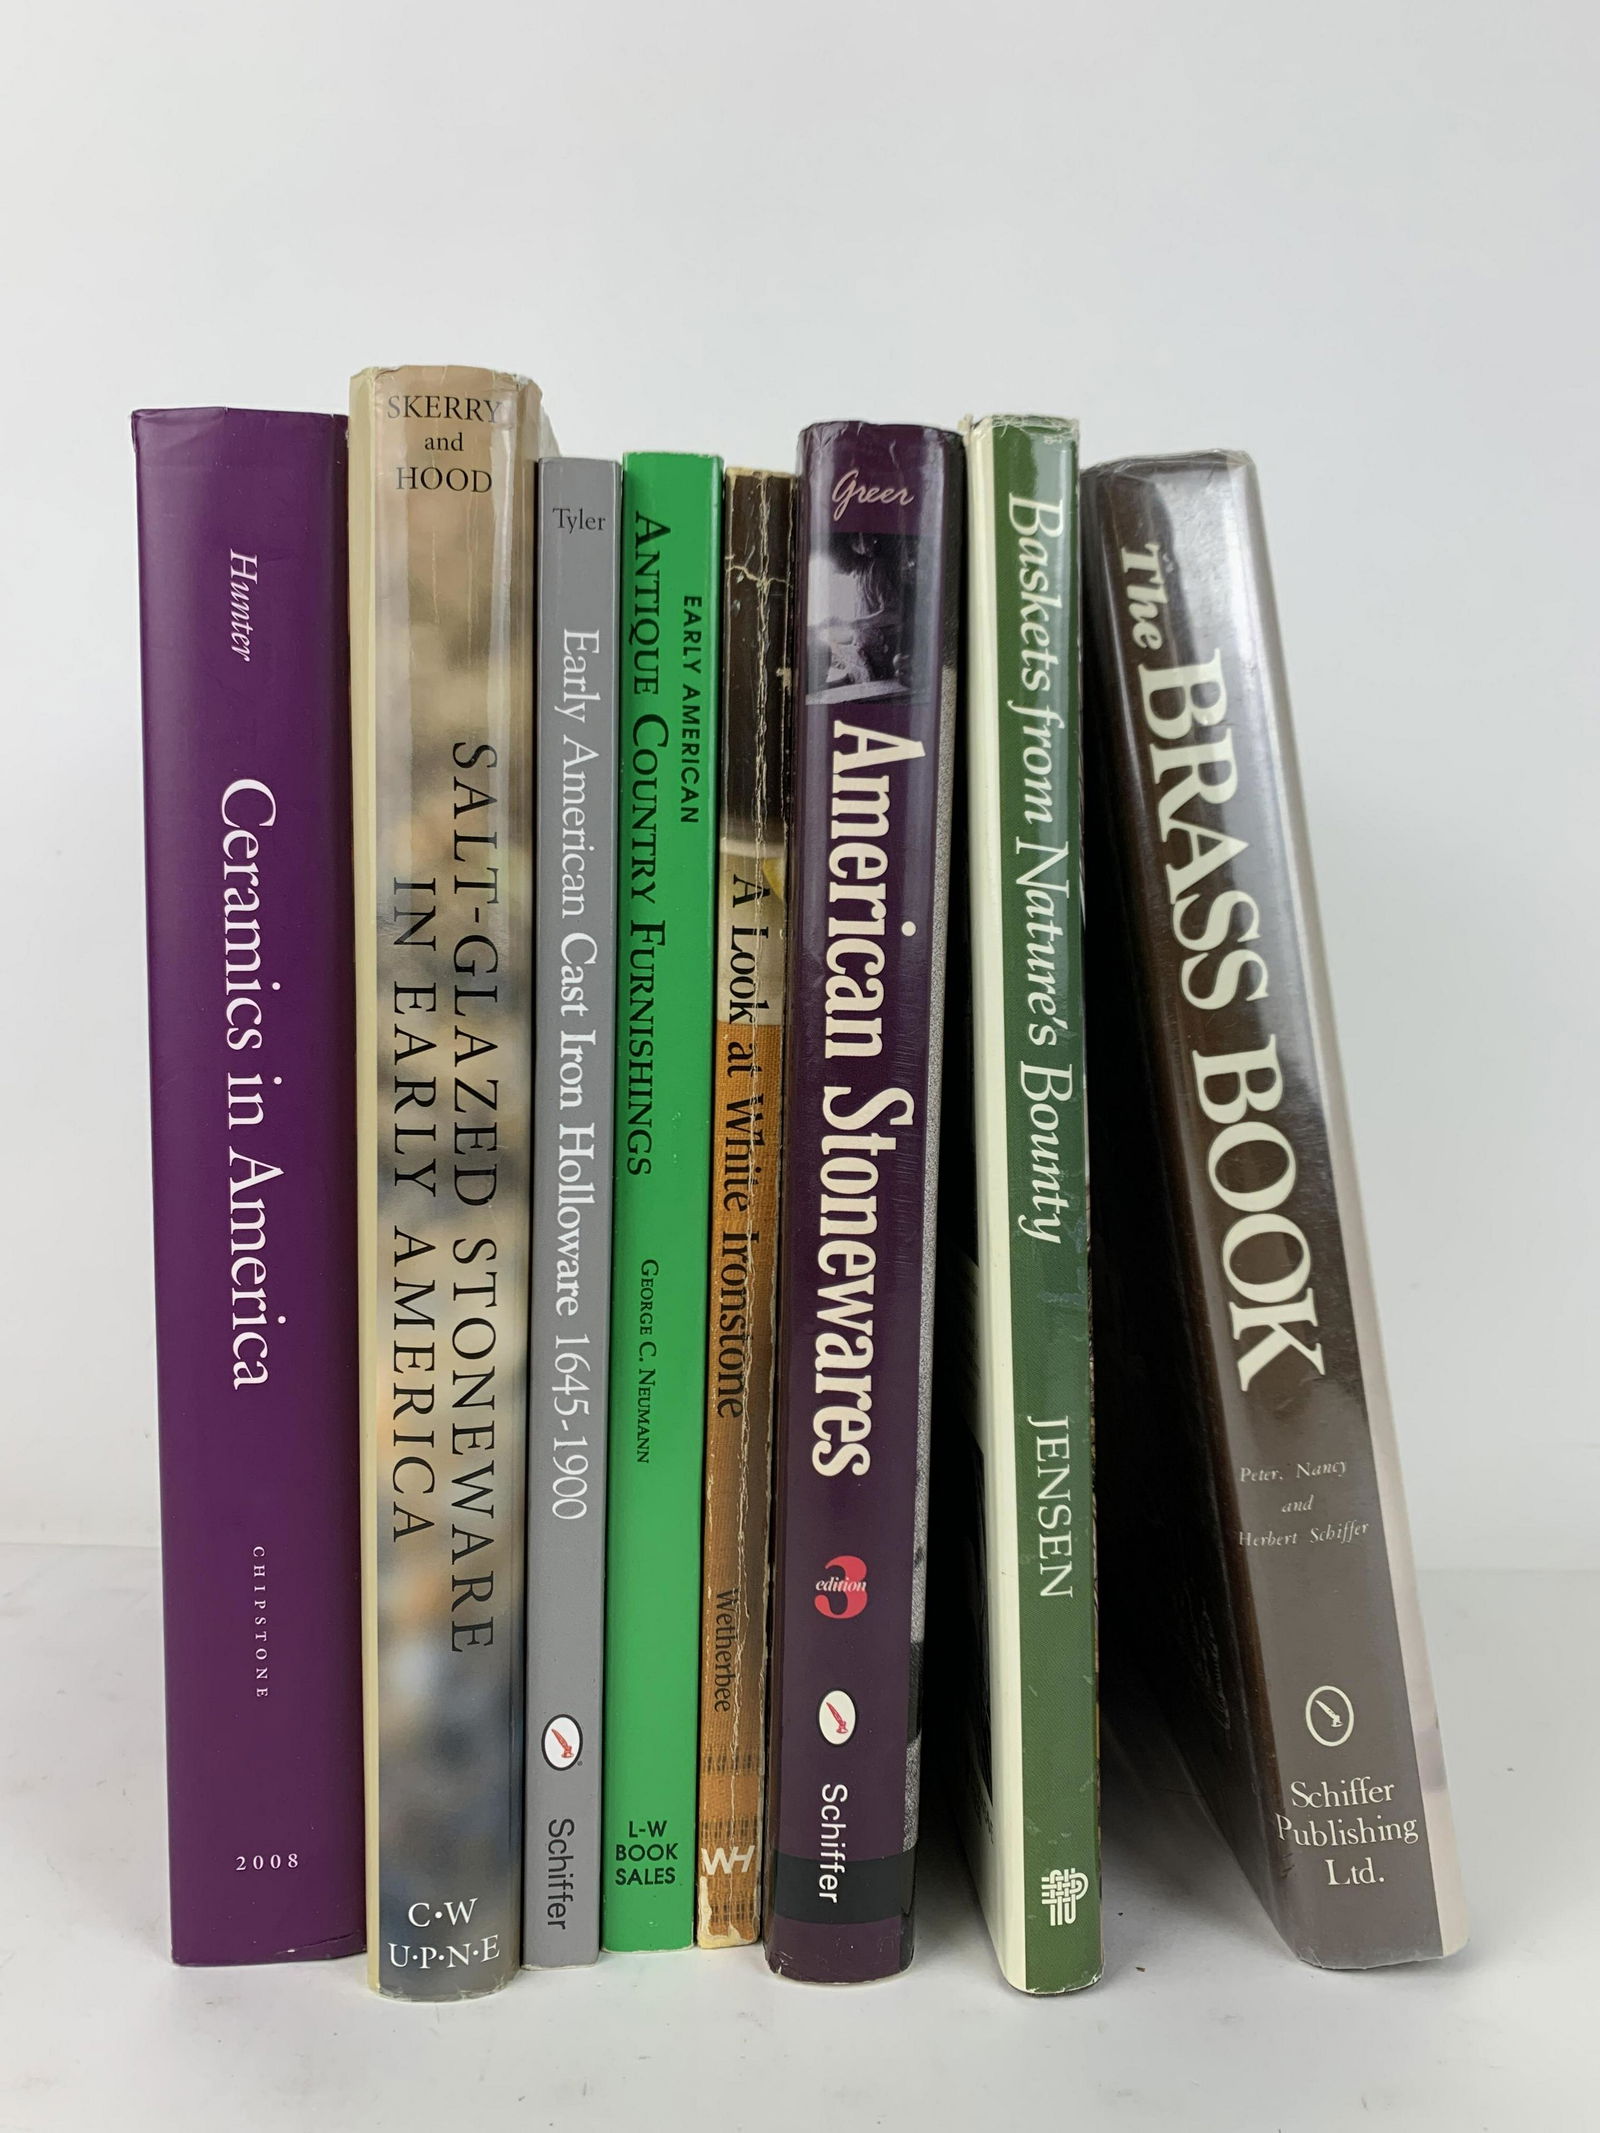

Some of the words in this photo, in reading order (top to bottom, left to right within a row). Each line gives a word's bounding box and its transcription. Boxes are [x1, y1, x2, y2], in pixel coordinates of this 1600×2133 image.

[387, 395, 502, 423] SKERRY
[424, 432, 464, 451] and
[396, 466, 492, 493] HOOD
[552, 507, 606, 535] Tyler
[229, 548, 259, 663] Hunter
[632, 511, 671, 697] ANTIQUE
[683, 595, 703, 674] EARLY
[1008, 492, 1063, 692] Baskets
[1120, 542, 1169, 651] The
[555, 628, 601, 725] Early
[680, 683, 700, 824] AMERICAN
[1007, 699, 1066, 825] from
[561, 734, 600, 920] American
[630, 714, 671, 904] COUNTRY
[1138, 648, 1270, 1011] BRASS
[220, 778, 282, 1050] Ceramics
[393, 876, 438, 950] IN
[733, 875, 771, 907] A
[825, 719, 926, 1060] American
[1015, 837, 1069, 1046] Nature's
[453, 741, 498, 1207] SALT-GLAZED
[559, 932, 600, 1017] Cast
[730, 923, 769, 1024] Look
[226, 1072, 283, 1131] in
[393, 980, 438, 1194] EARLY
[558, 1029, 598, 1111] Iron
[628, 922, 667, 1175] FURNISHINGS
[728, 1040, 765, 1078] at
[722, 1092, 764, 1212] White
[1017, 1061, 1075, 1246] Bounty
[227, 1146, 287, 1390] America
[555, 1124, 598, 1318] Holloware
[1192, 1034, 1326, 1393] BOOK
[639, 1259, 660, 1336] GEORGE
[717, 1231, 760, 1419] Ironstone
[811, 1085, 916, 1478] Stonewares
[391, 1224, 436, 1545] AMERICA
[636, 1342, 656, 1363] C.
[449, 1238, 498, 1653] STONEWARE
[550, 1334, 591, 1522] 1645-1900
[634, 1369, 654, 1464] NEUMANN
[1296, 1461, 1347, 1479] Nancy
[1028, 1415, 1074, 1599] JENSEN
[1239, 1531, 1298, 1547] Herbert
[1310, 1519, 1369, 1545] Schiffer
[1281, 1494, 1314, 1513] and
[251, 1545, 269, 1699] CHIPSTONE
[814, 1555, 868, 1619] 3
[815, 1577, 867, 1592] edition
[712, 1589, 734, 1713] Wetherbee
[628, 1821, 667, 1841] L-W
[818, 1783, 849, 1905] Schiffer
[1276, 1813, 1419, 1849] Publishing
[1290, 1776, 1395, 1809] Schiffer
[234, 1851, 301, 1873] 2008
[547, 1818, 575, 1930] Schiffer
[615, 1843, 678, 1862] BOOK
[615, 1865, 675, 1886] SALES
[1326, 1860, 1385, 1887] Ltd.
